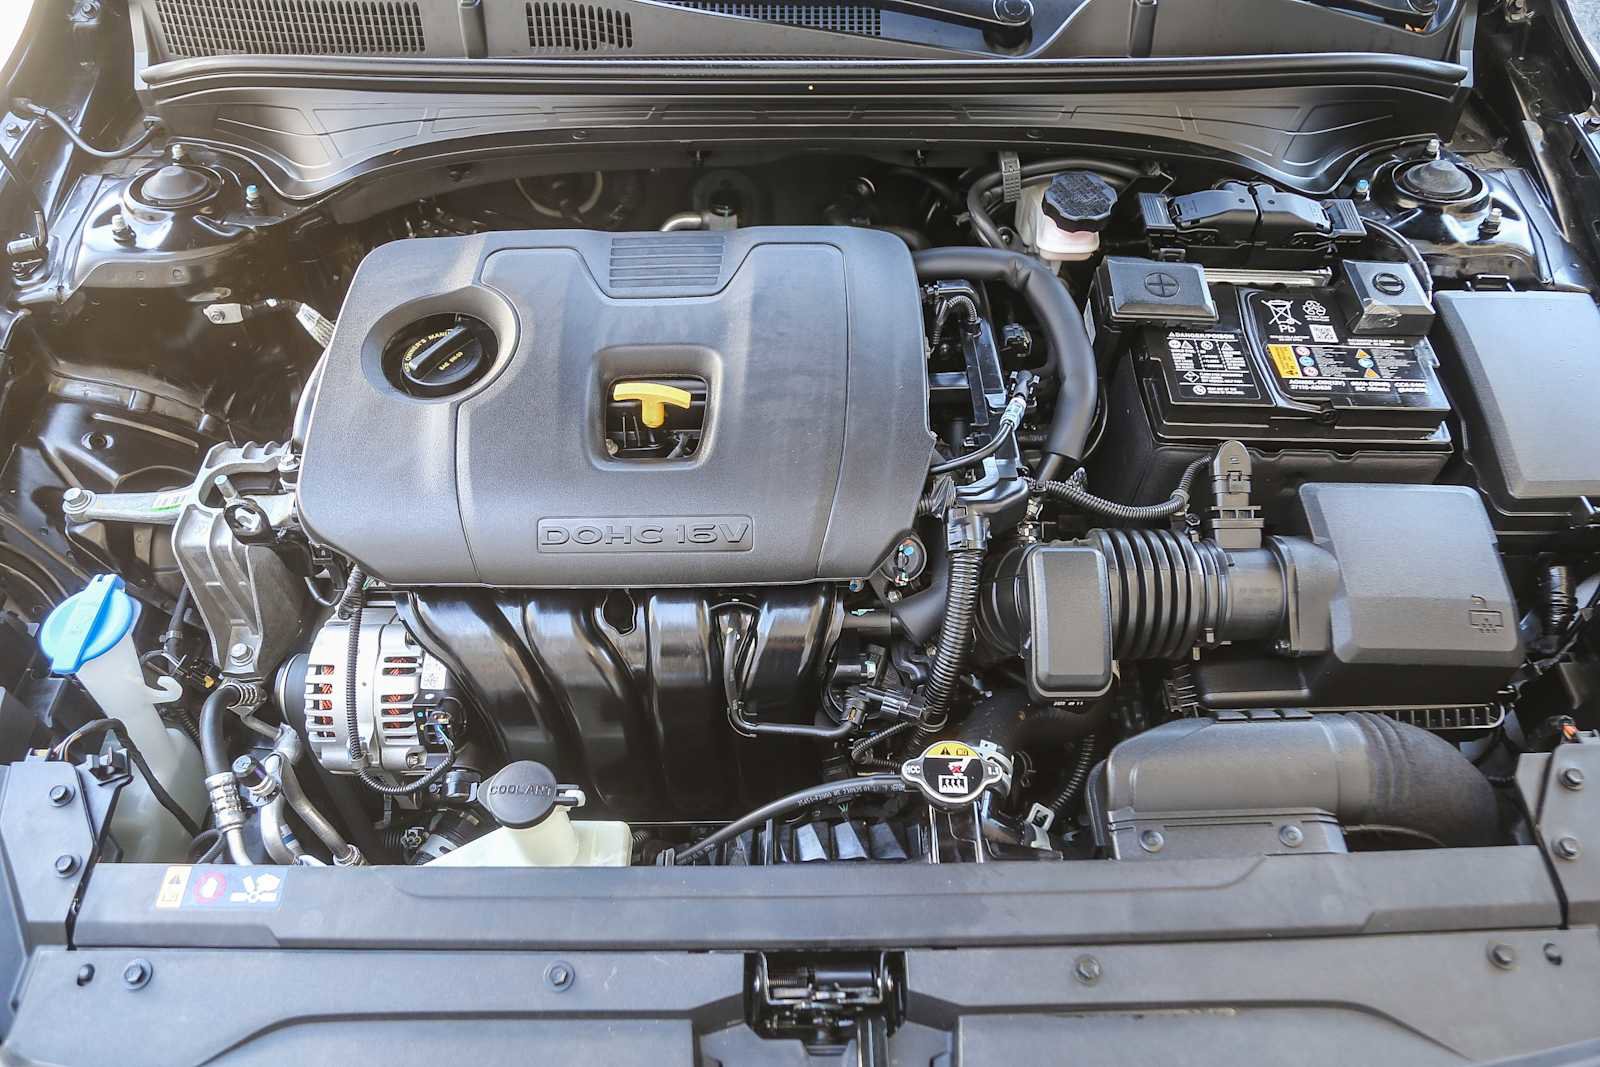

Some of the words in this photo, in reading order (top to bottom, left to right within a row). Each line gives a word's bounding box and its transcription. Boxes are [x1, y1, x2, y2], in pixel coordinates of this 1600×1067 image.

[1278, 324, 1296, 333] Pb
[541, 524, 663, 546] DOHC
[676, 523, 749, 544] 16V
[489, 783, 552, 797] COOLANT
